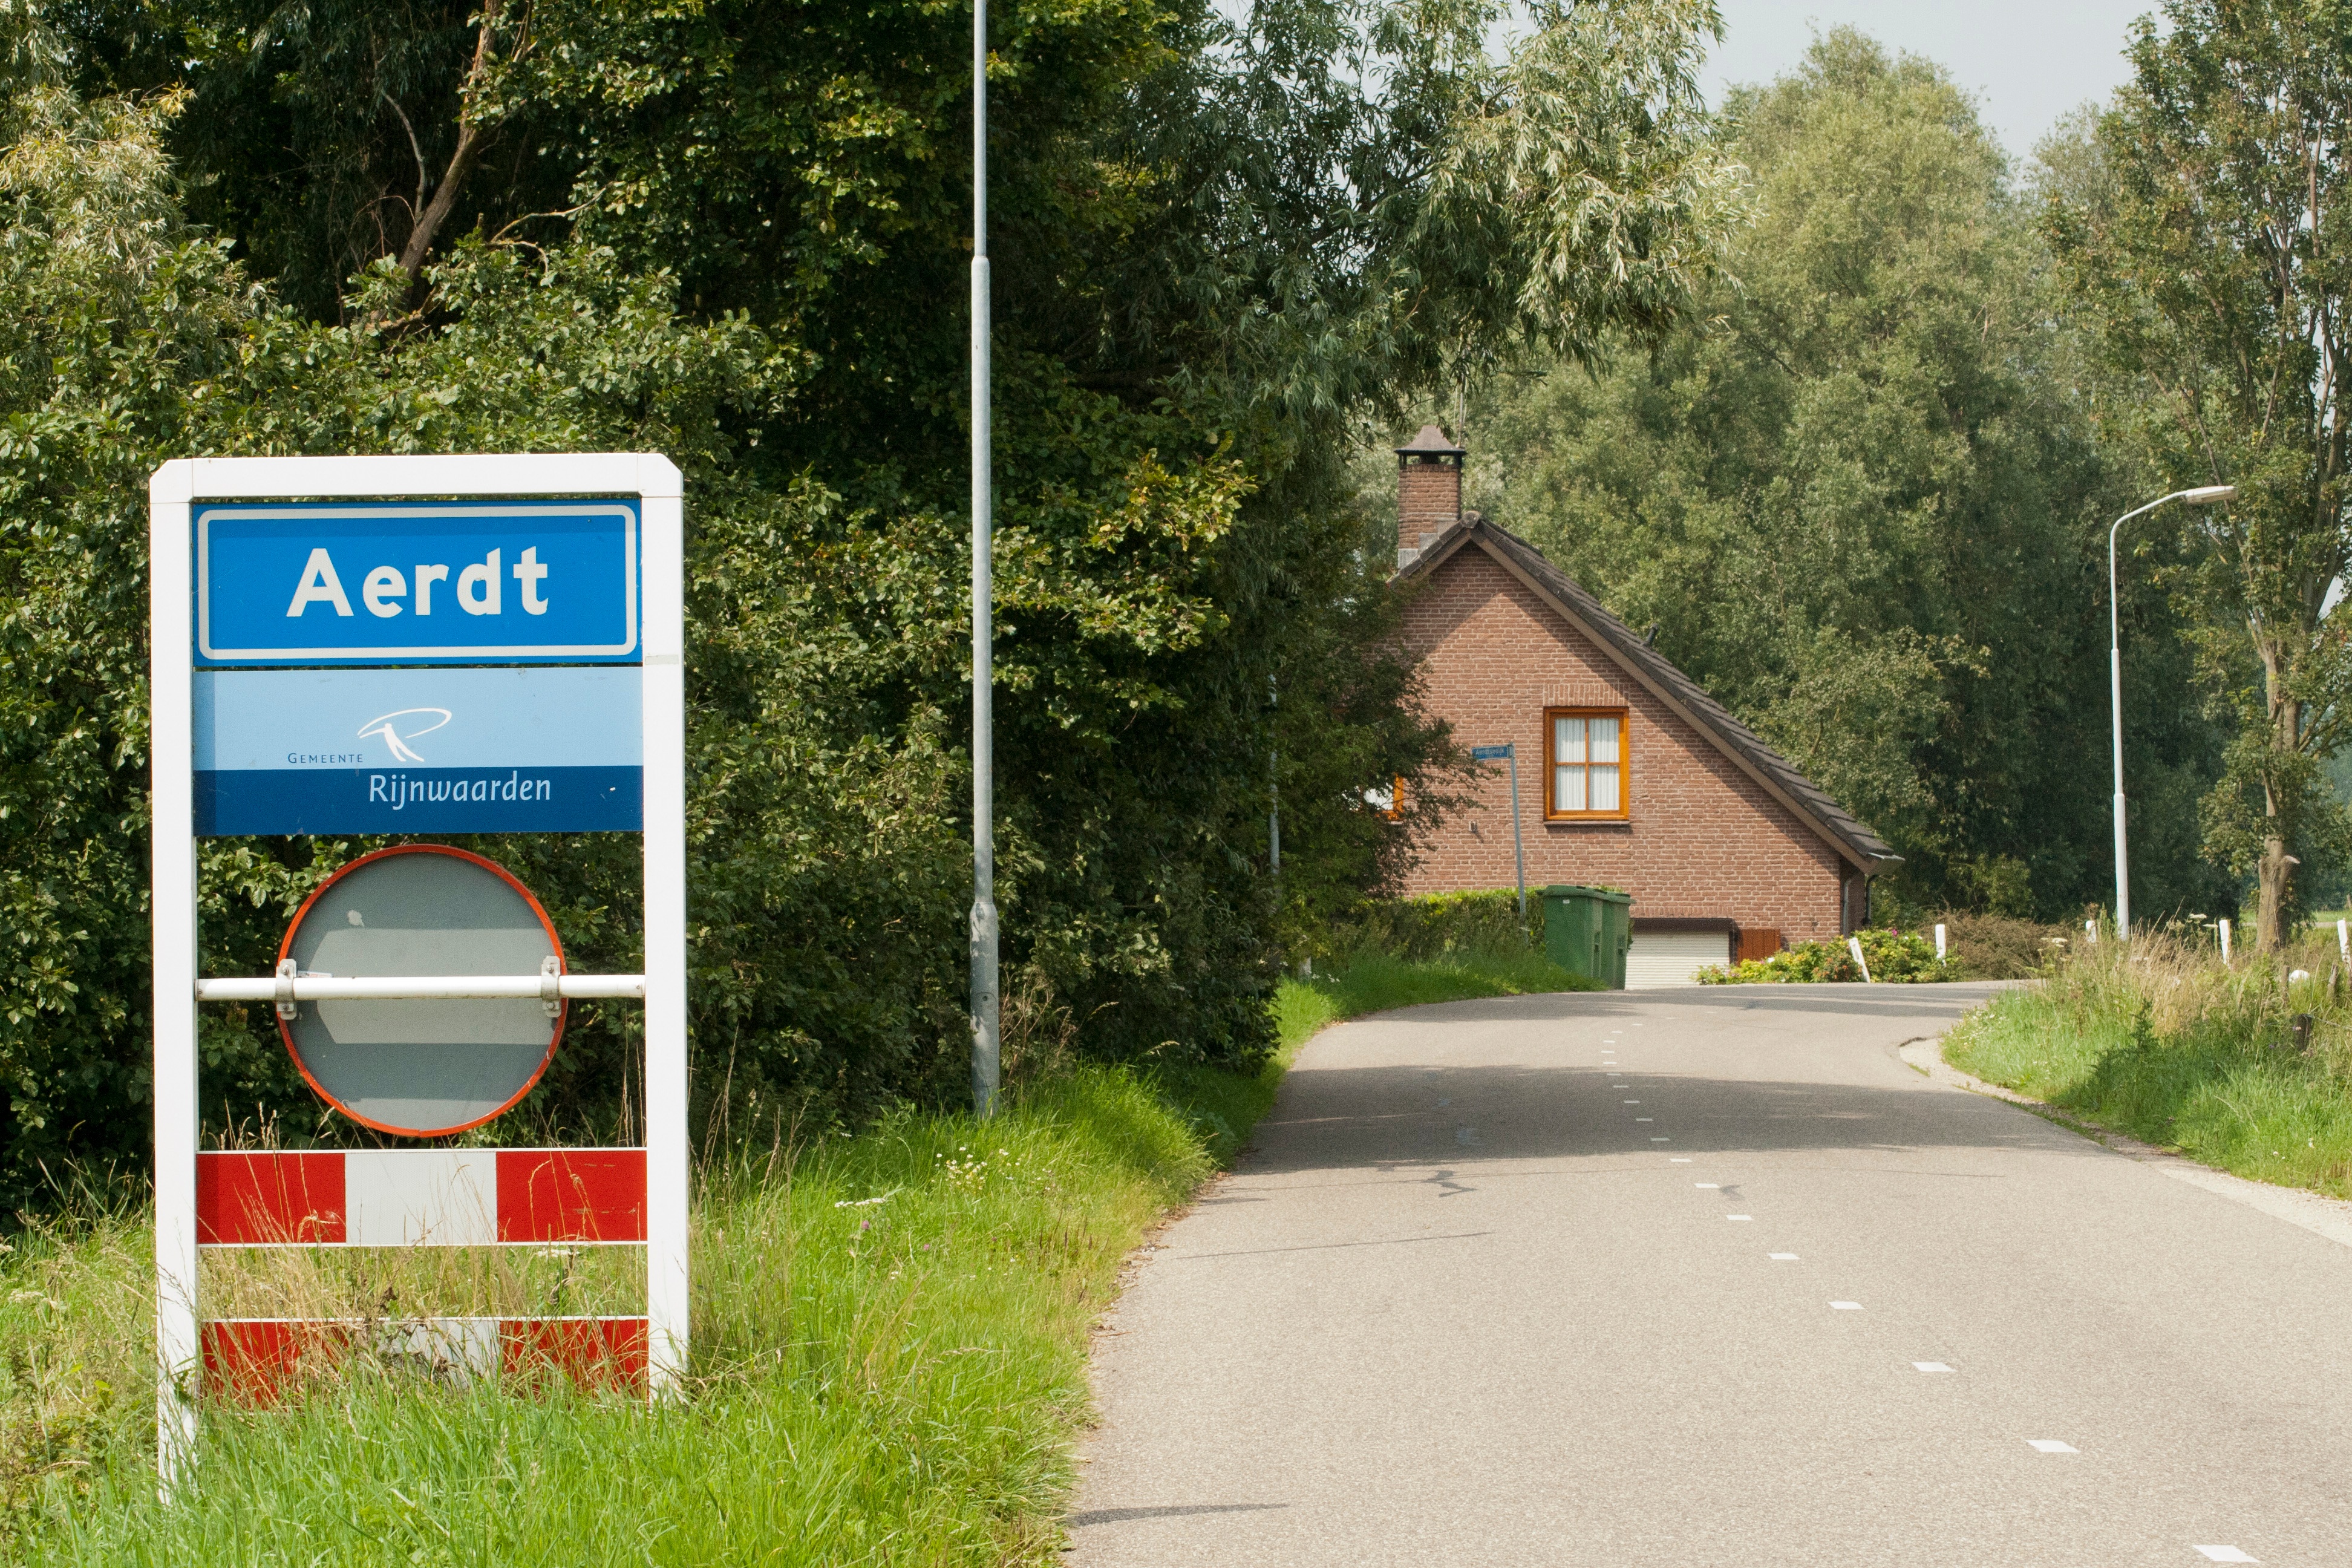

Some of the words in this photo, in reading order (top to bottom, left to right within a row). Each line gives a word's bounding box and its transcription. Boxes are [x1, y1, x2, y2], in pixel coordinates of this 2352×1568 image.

[287, 546, 549, 618] Aerdt
[287, 753, 363, 764] GEMEENTE
[370, 771, 550, 810] Rijnwaarden
